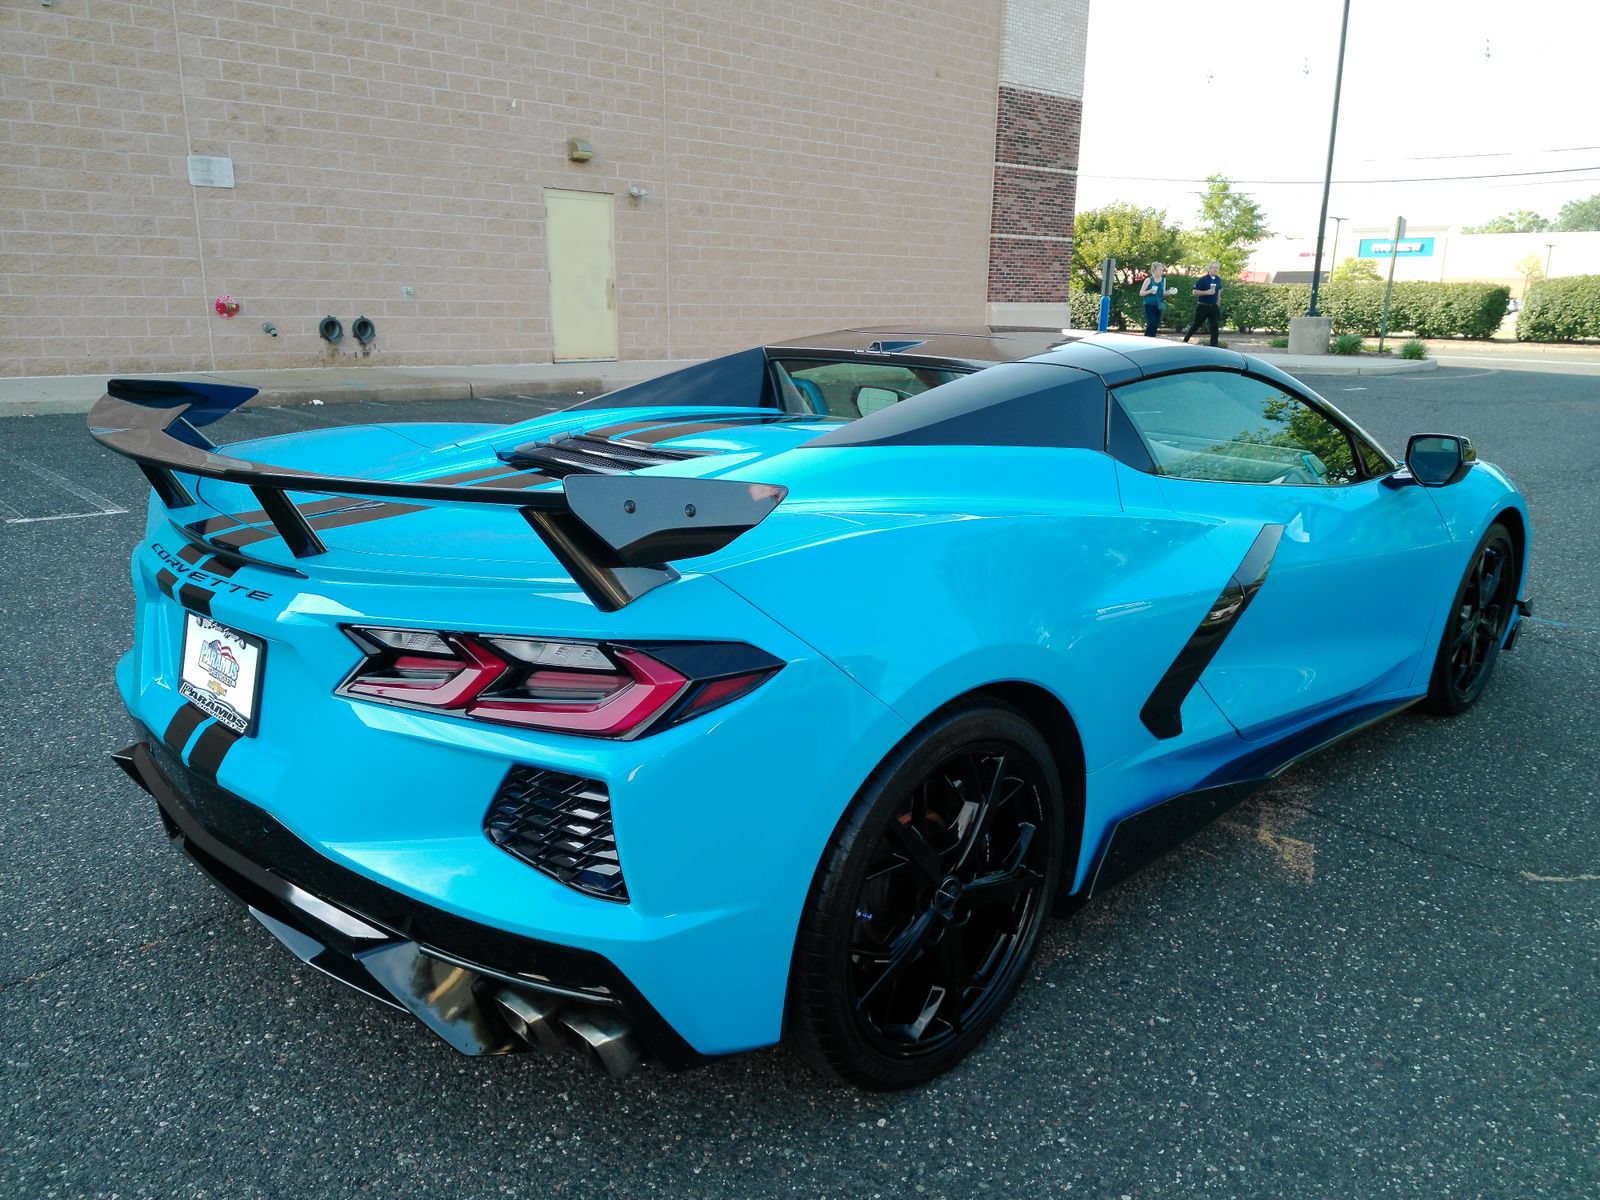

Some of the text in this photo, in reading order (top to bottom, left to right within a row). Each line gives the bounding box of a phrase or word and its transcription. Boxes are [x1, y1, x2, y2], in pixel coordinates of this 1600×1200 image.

[151, 543, 273, 602] CORVETTE
[199, 640, 239, 681] PARAMUS
[181, 683, 247, 729] PARAMUS
